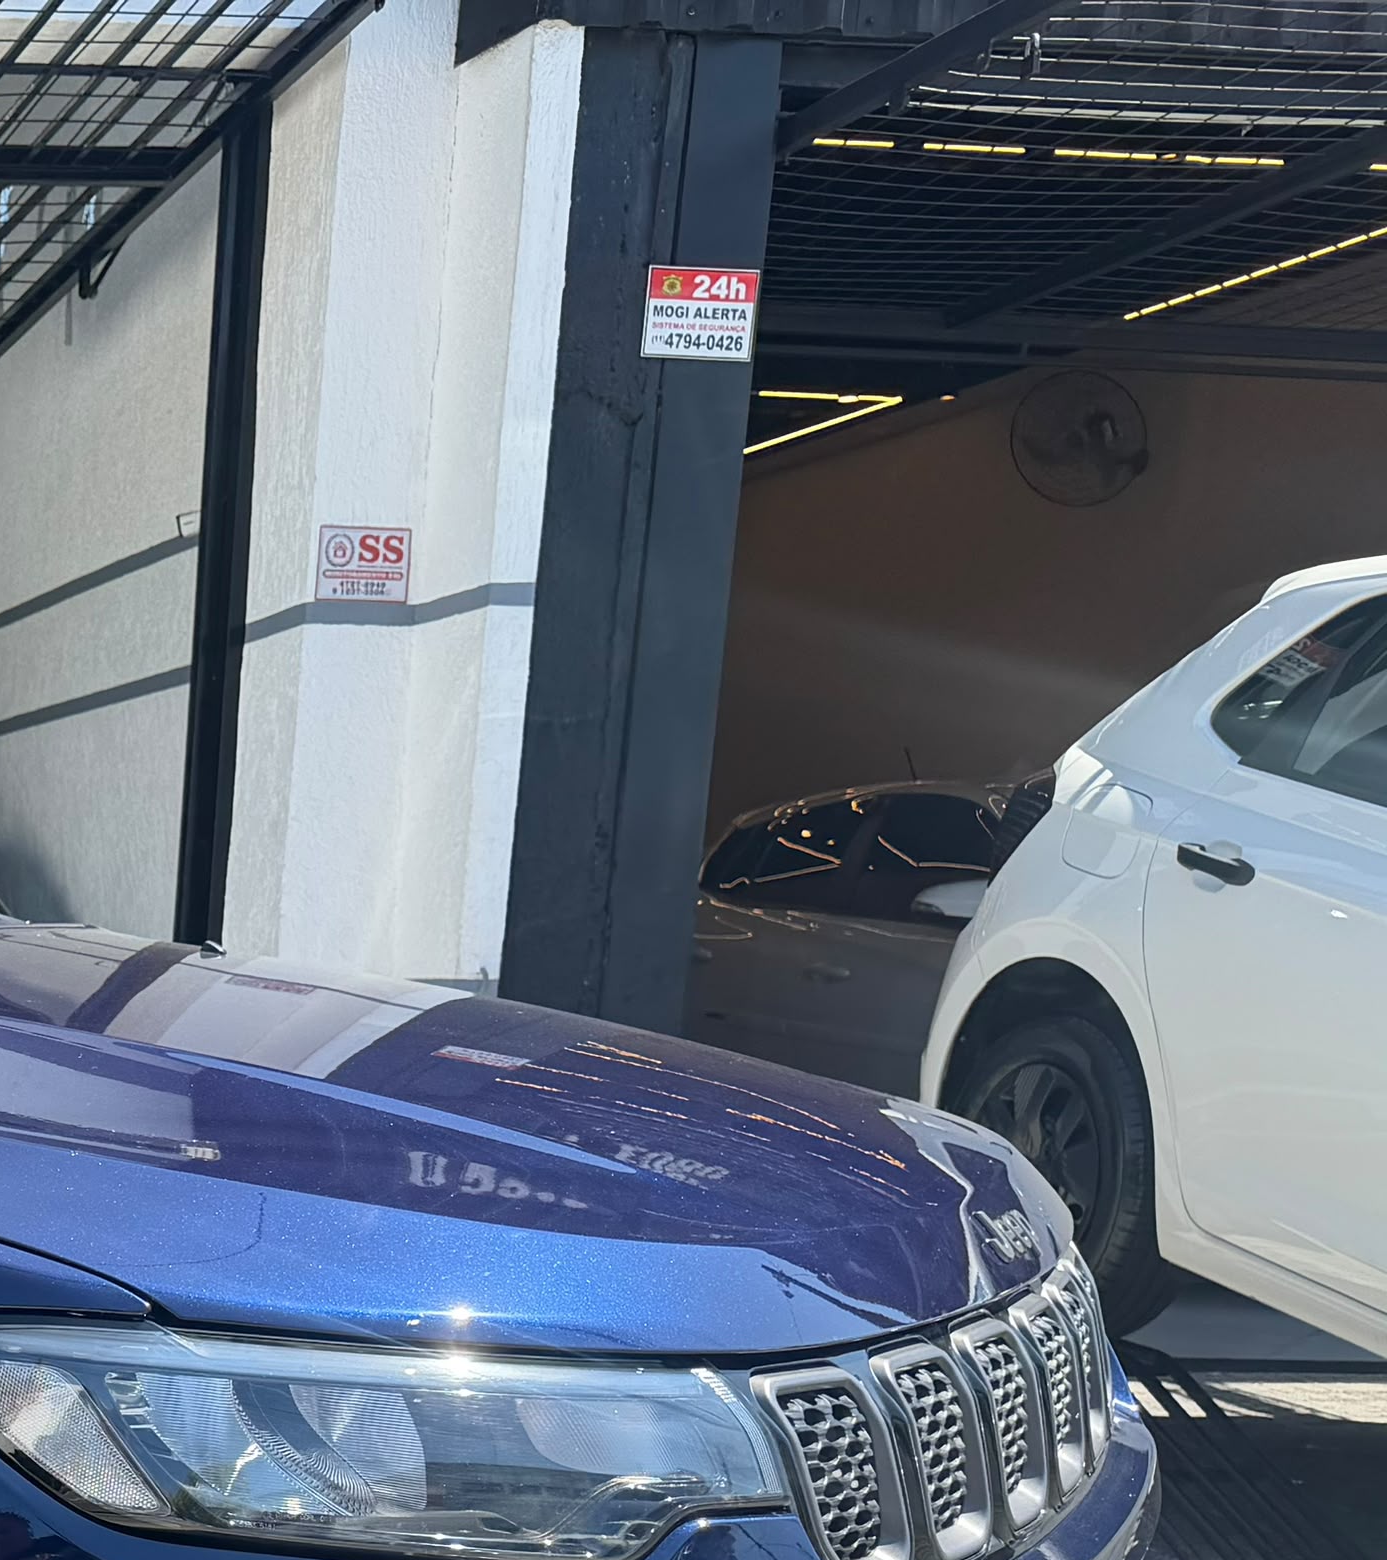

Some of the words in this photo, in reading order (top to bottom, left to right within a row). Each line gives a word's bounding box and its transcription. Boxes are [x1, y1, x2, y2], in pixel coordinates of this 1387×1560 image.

[692, 274, 747, 301] 24h
[653, 305, 689, 319] MOGI
[693, 307, 747, 321] ALERTA
[665, 332, 743, 352] 4794-0426
[358, 534, 404, 564] SS
[969, 1209, 1043, 1264] Jeep
